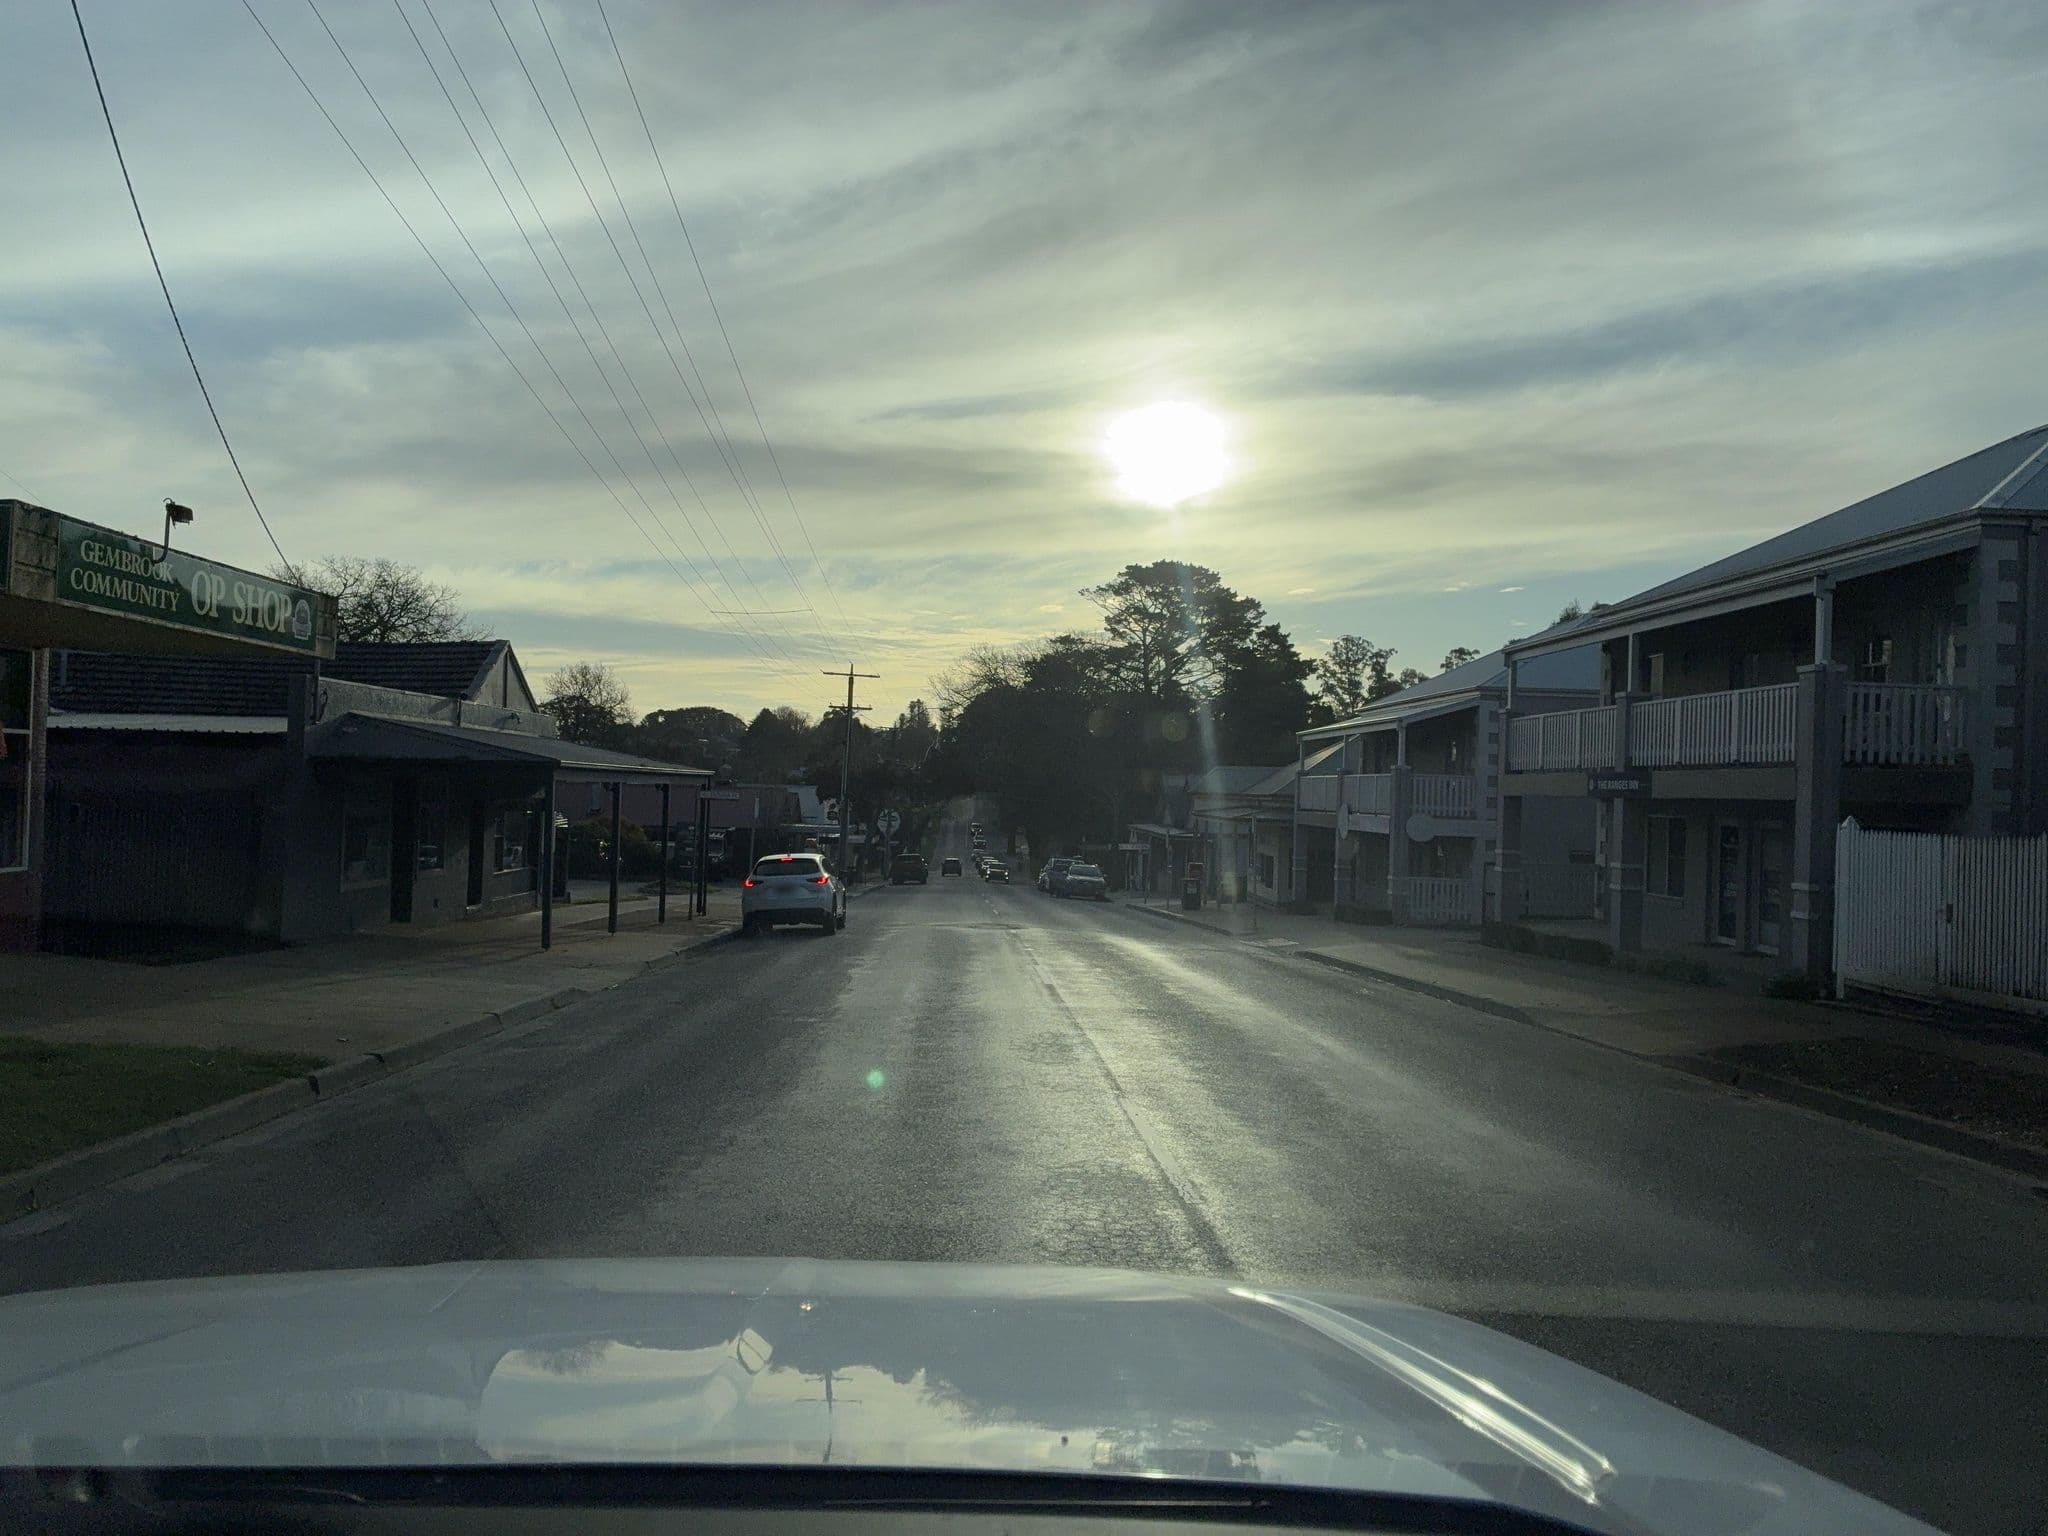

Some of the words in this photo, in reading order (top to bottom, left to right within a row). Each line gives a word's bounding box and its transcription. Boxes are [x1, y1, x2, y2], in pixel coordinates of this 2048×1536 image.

[80, 540, 175, 584] GEMBROOK
[70, 567, 180, 612] COMMUNITY
[191, 570, 226, 618] OP
[232, 580, 293, 633] SHOP
